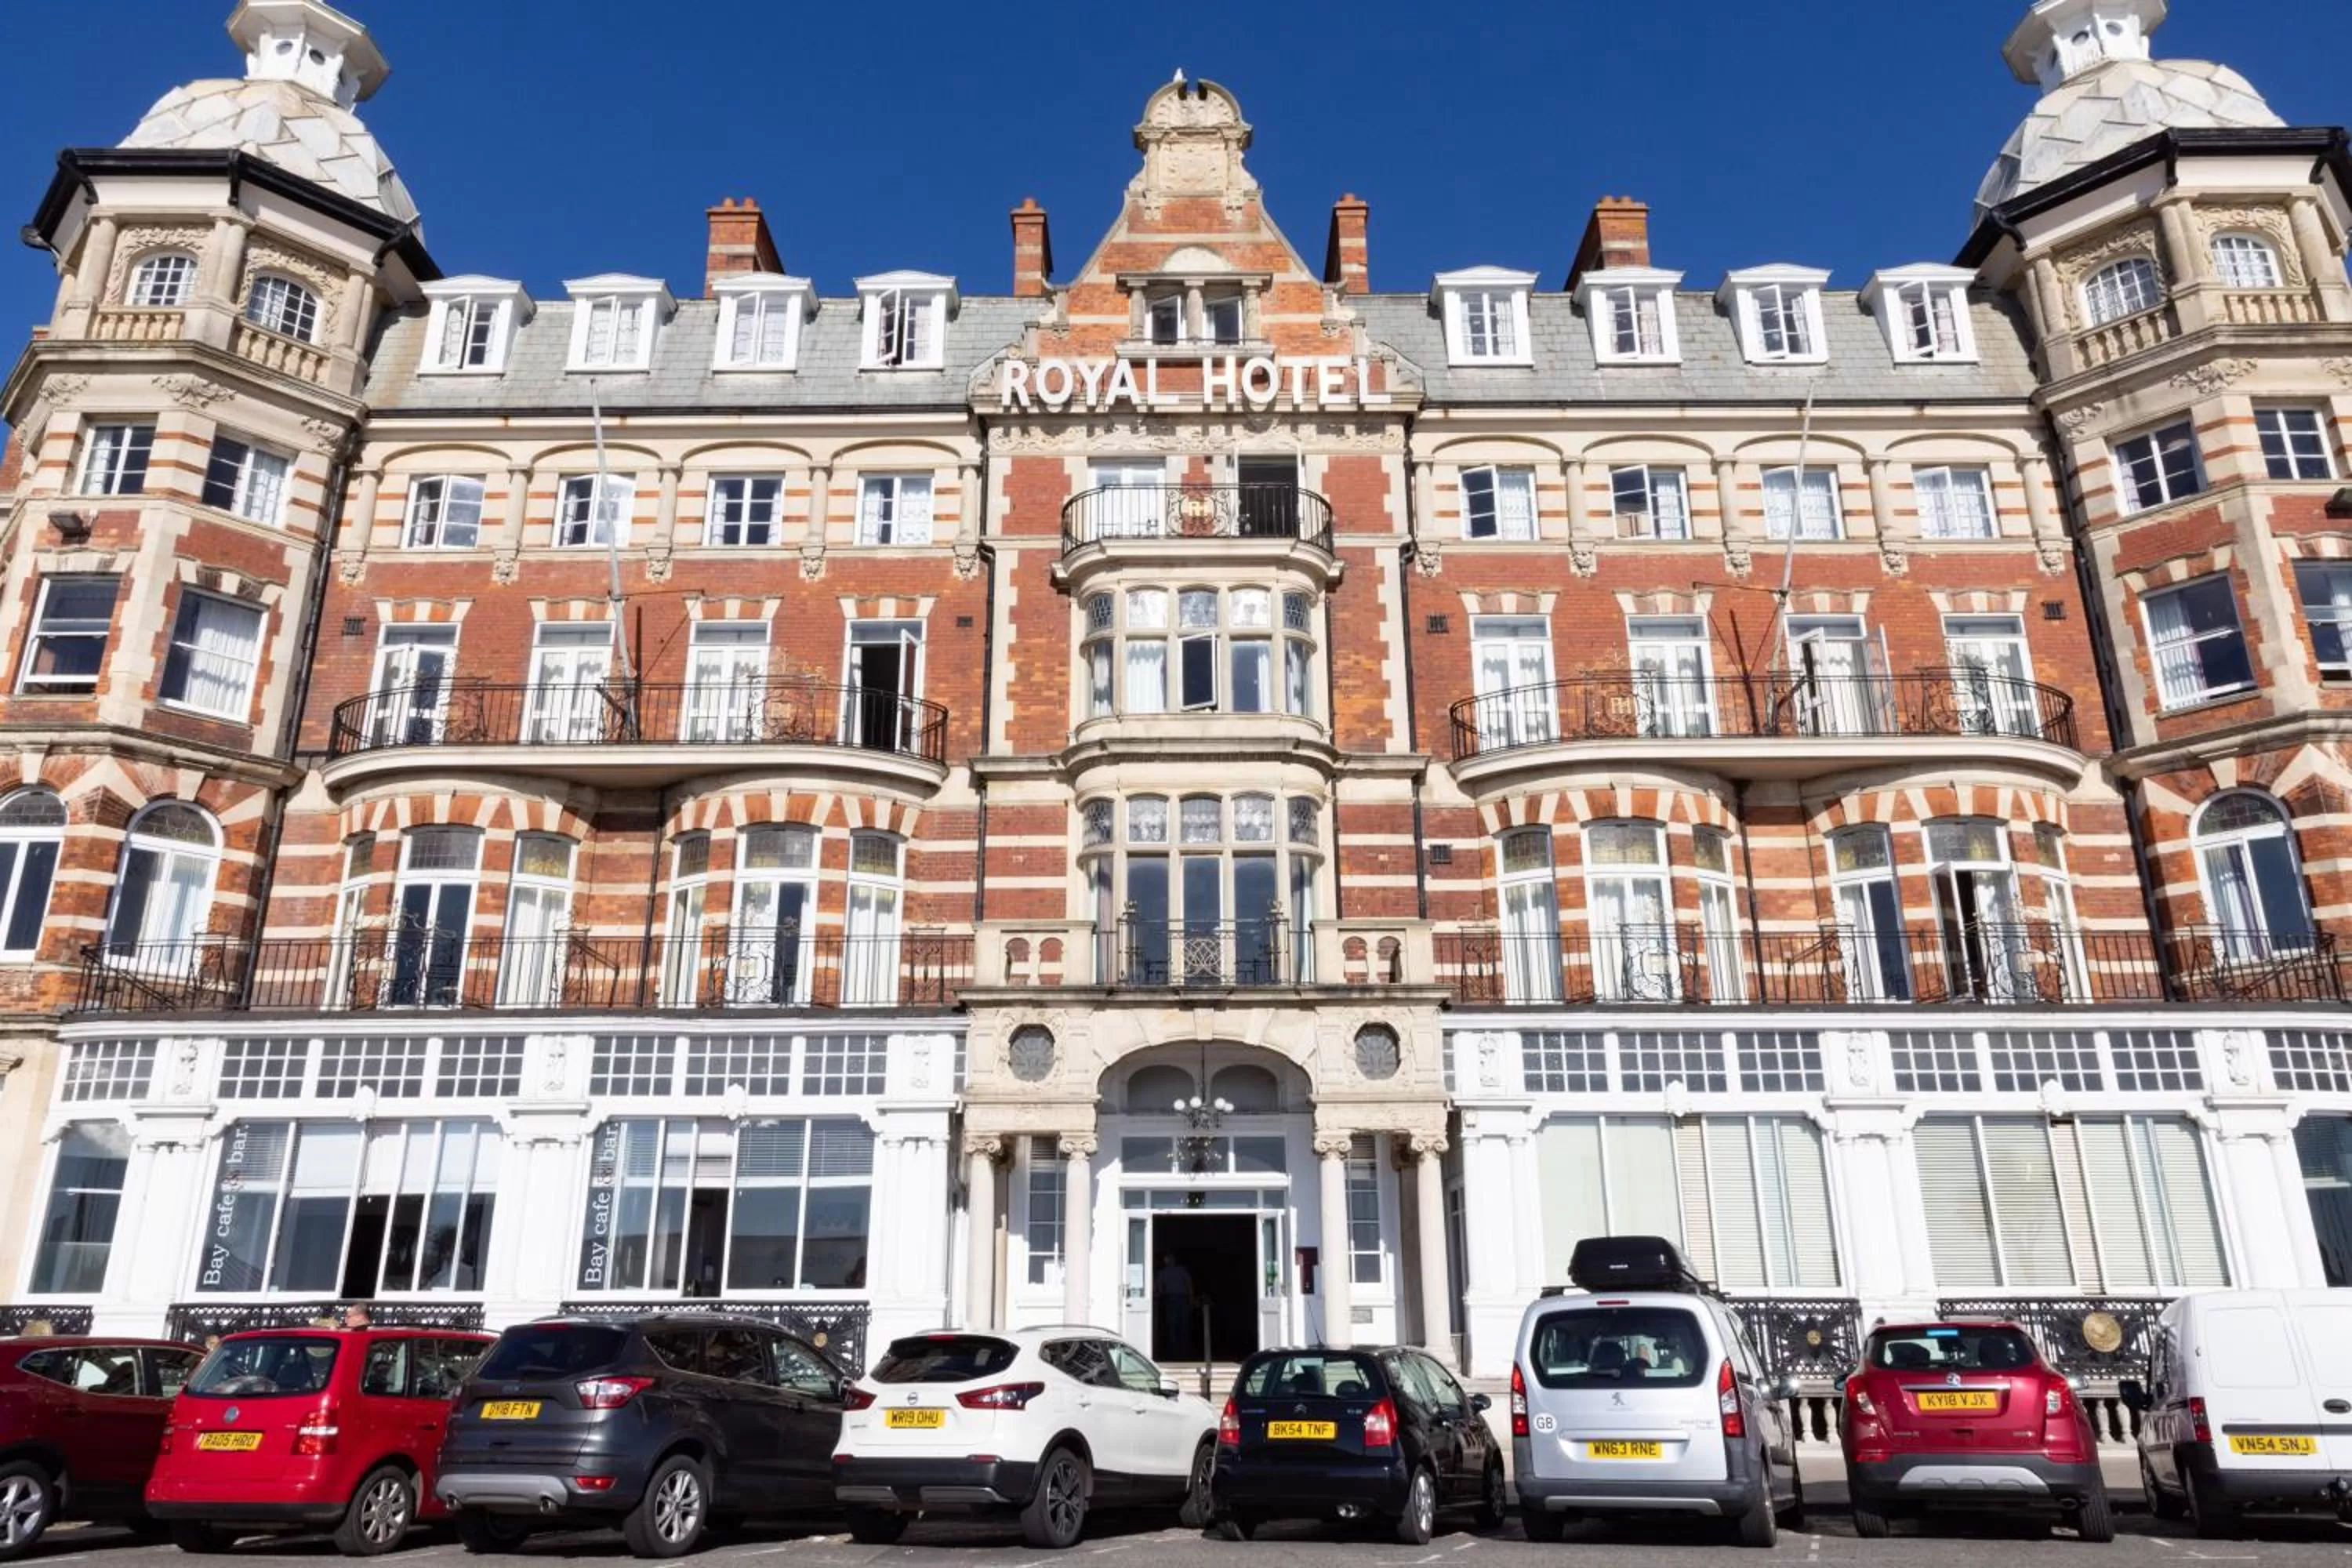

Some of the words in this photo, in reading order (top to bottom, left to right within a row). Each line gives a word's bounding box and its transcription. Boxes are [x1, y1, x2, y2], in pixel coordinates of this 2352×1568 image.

[1001, 358, 1181, 406] ROYAL
[1203, 355, 1392, 405] HOTEL
[203, 1243, 229, 1285] Bay
[216, 1194, 236, 1237] cafe
[226, 1123, 250, 1164] bar.
[592, 1192, 610, 1236] cafe
[584, 1242, 609, 1283] Bay
[1927, 1394, 1957, 1406] KY18
[1959, 1393, 1987, 1406] VJX
[511, 1402, 534, 1415] FTN
[1273, 1423, 1302, 1436] BK54
[1307, 1423, 1330, 1436] TNF
[1536, 1417, 1553, 1429] GB
[1592, 1442, 1627, 1456] WN63
[1630, 1442, 1657, 1456] RNE
[2235, 1437, 2275, 1450] VN54
[2279, 1437, 2310, 1451] SNJ
